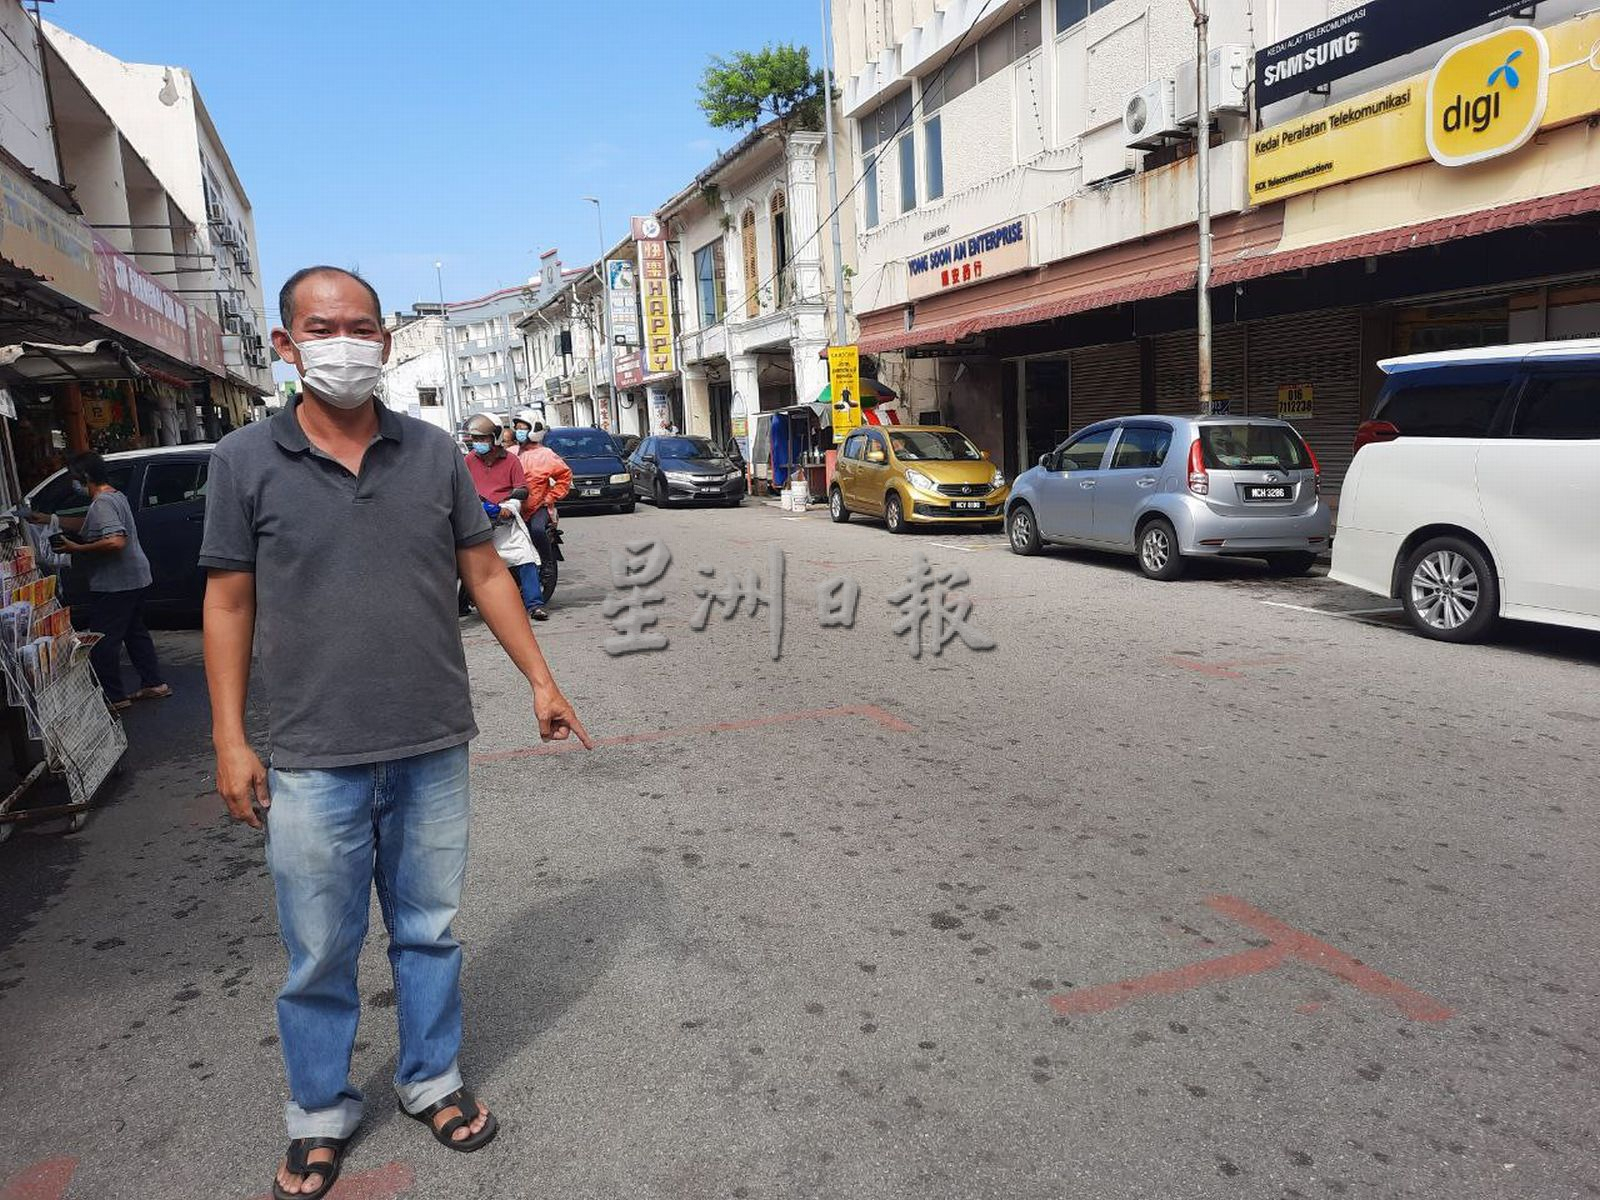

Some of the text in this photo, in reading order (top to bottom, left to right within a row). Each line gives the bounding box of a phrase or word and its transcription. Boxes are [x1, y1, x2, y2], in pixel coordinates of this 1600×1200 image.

[1304, 8, 1367, 41] TELEKOMUNIKASI
[1263, 31, 1361, 87] SAMSUNG
[1255, 88, 1412, 156] Kedai Peralatan Telekomunikasi
[1442, 90, 1500, 133] digi
[1268, 161, 1334, 187] Telecommunications
[930, 246, 952, 269] SOON
[954, 241, 966, 261] AN
[968, 221, 1023, 256] ENTERPRISE
[648, 281, 668, 370] HAPPY
[1288, 389, 1303, 400] 016
